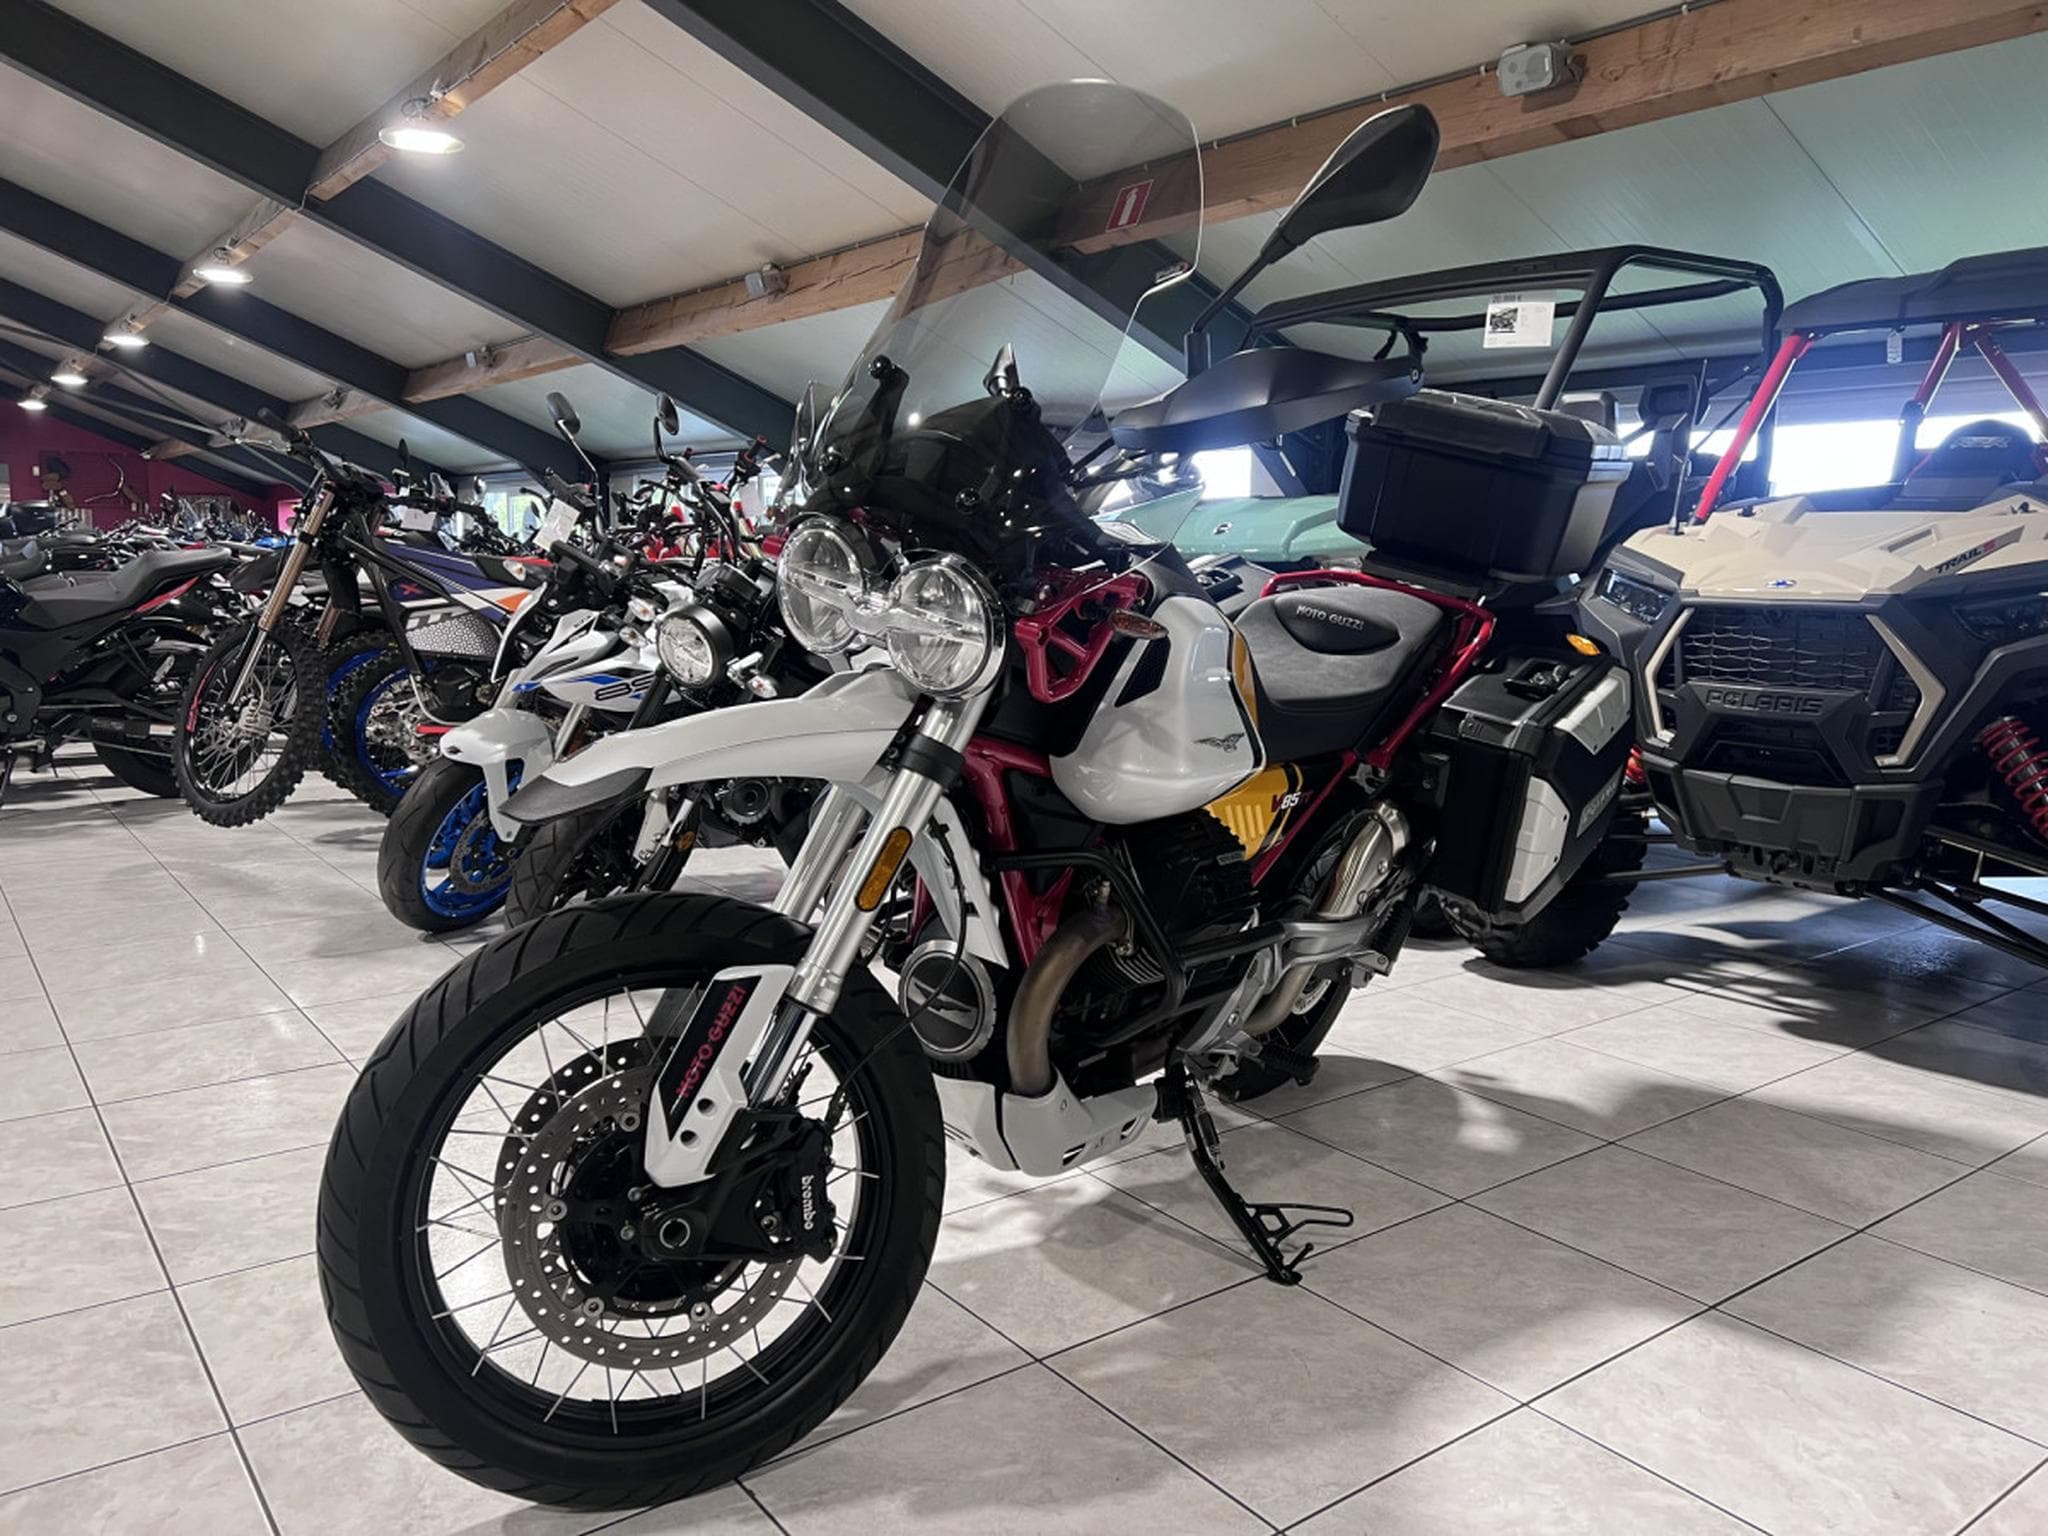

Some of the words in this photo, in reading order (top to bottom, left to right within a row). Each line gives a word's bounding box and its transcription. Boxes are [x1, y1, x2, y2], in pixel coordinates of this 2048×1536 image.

[1296, 604, 1328, 620] MOTO
[1328, 613, 1365, 631] GUZZI
[1706, 688, 1825, 716] POLARIS
[676, 1043, 714, 1098] MOTO
[708, 984, 748, 1042] GUZZI
[801, 1174, 817, 1231] brembo
